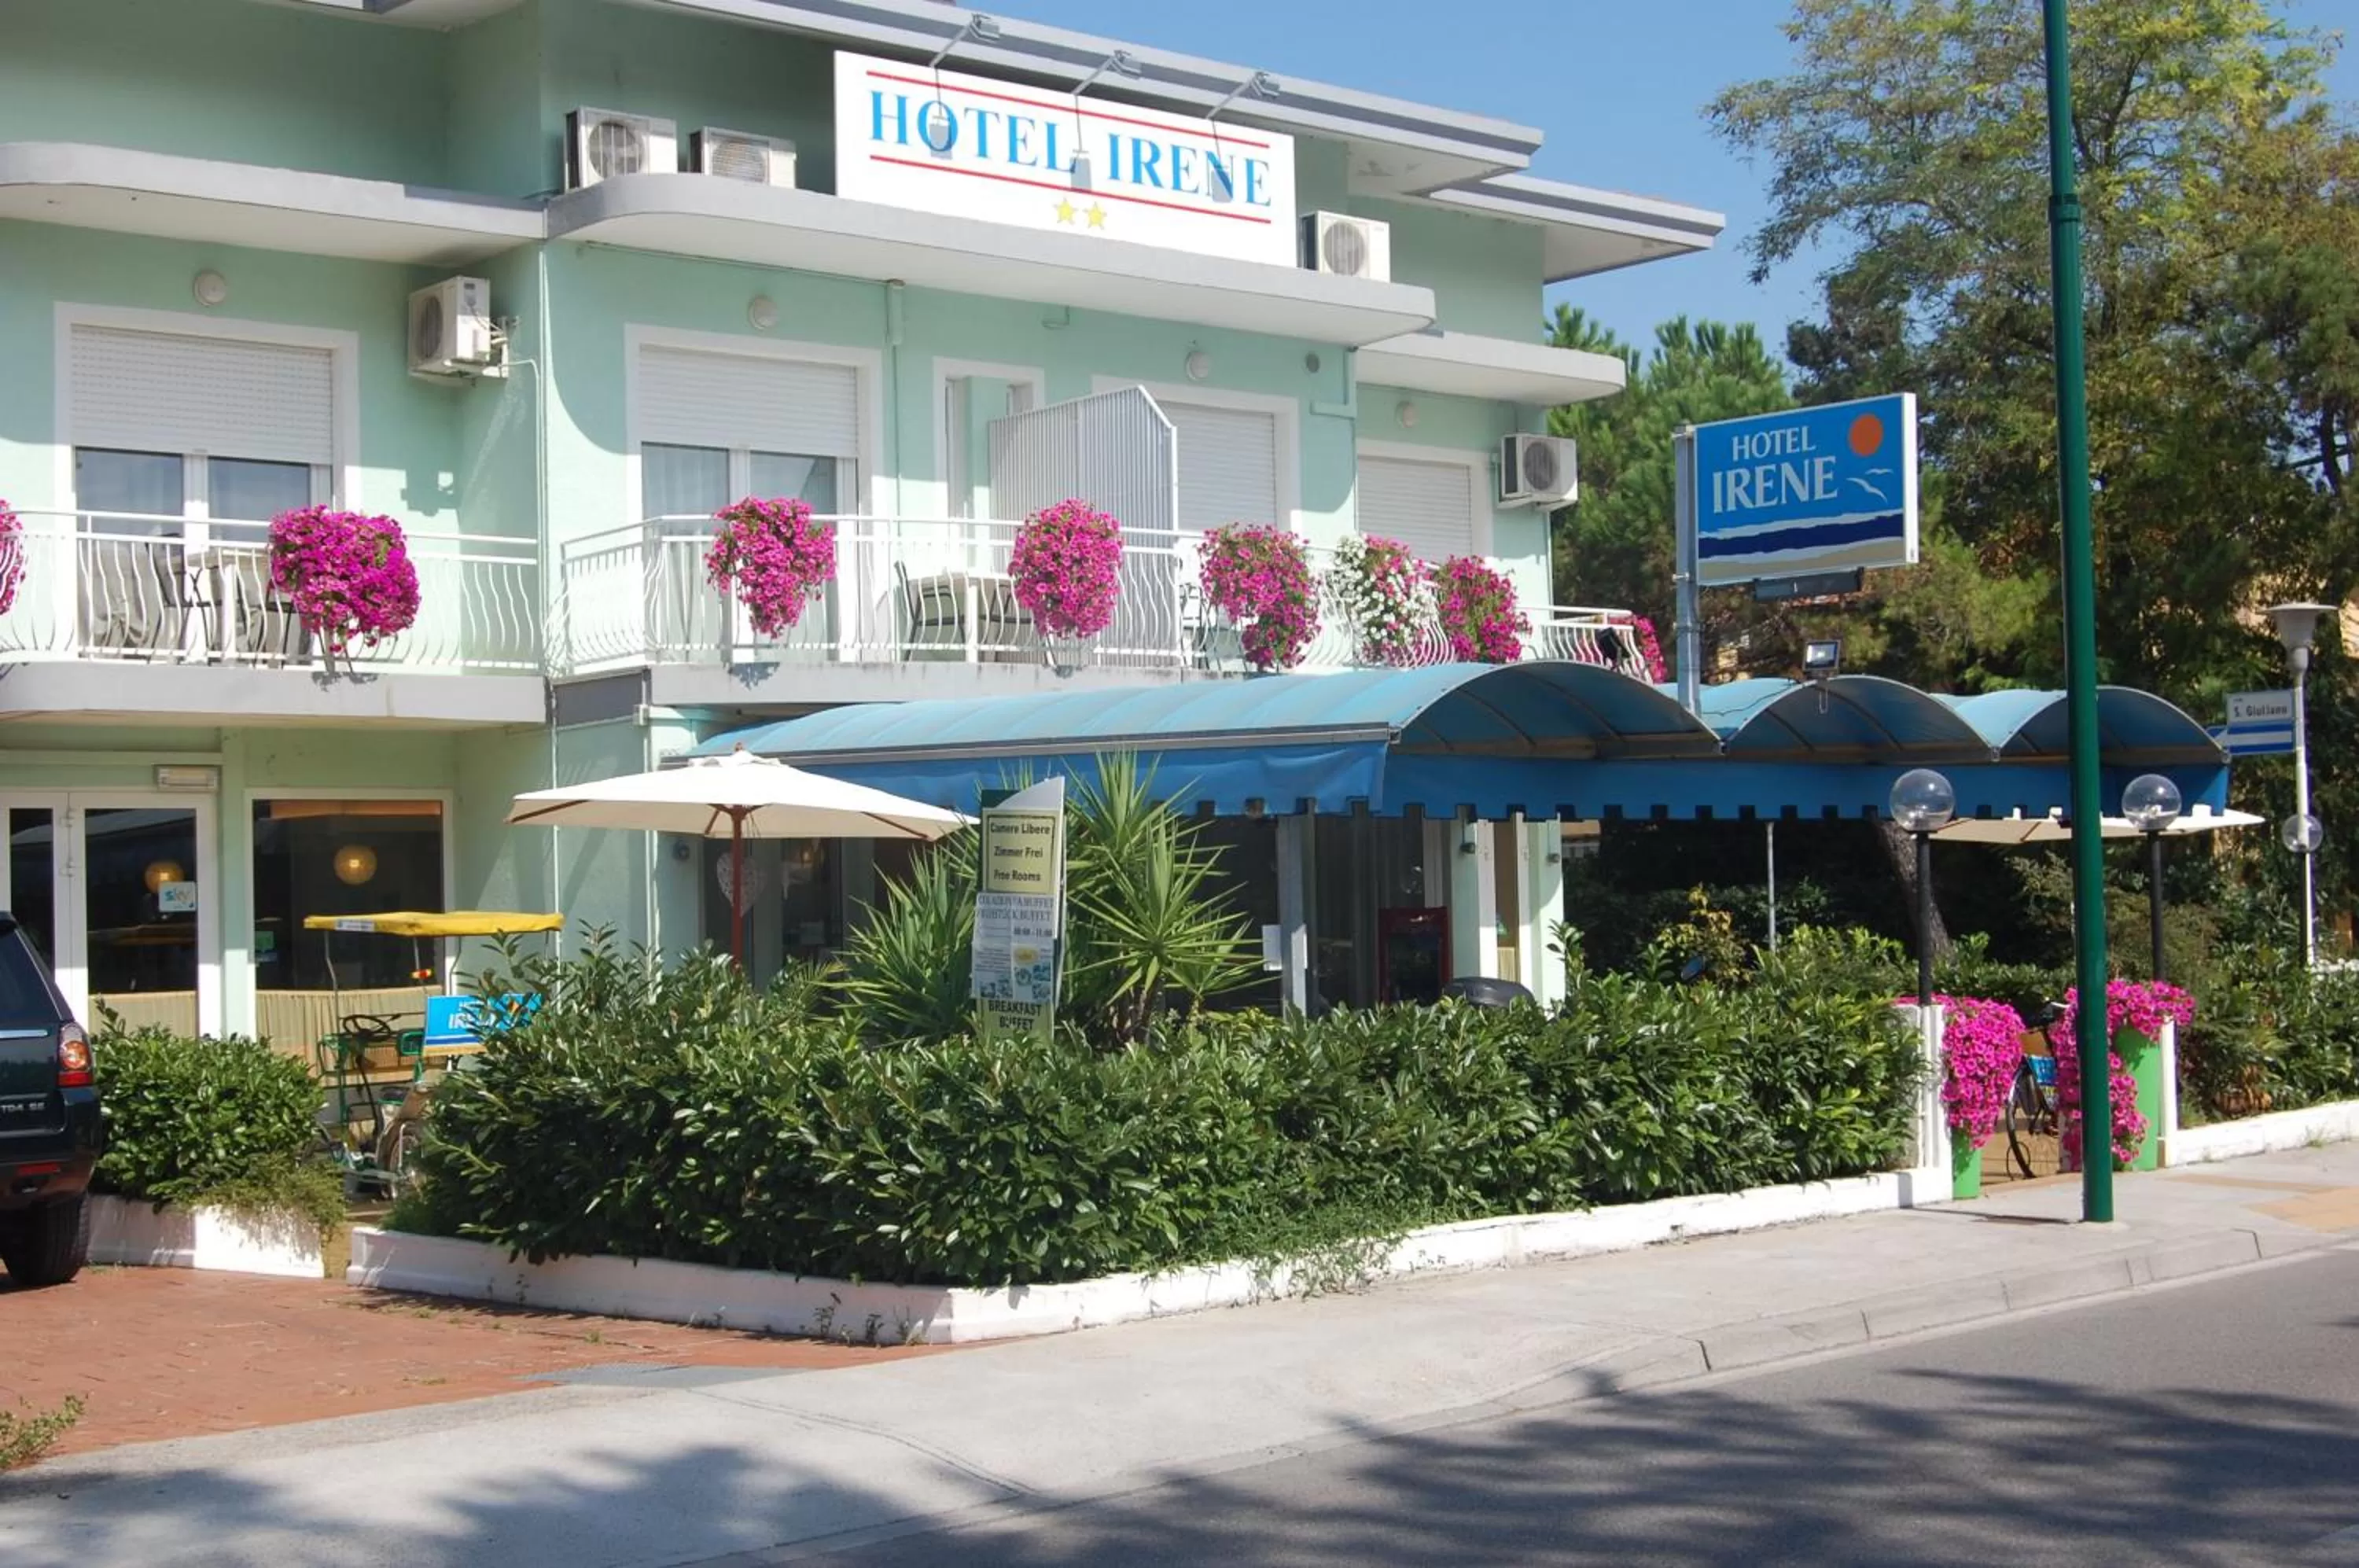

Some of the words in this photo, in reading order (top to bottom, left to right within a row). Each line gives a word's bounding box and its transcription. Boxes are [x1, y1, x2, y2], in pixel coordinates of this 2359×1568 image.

[868, 89, 1077, 174] HOTEL
[1107, 132, 1272, 207] IRENE
[1732, 425, 1816, 462] HOTEL
[1713, 456, 1838, 514] IRENE
[1021, 823, 1051, 835] Libere
[994, 845, 1023, 856] Zimmer
[1025, 846, 1043, 858] Frei
[994, 870, 1010, 880] Free
[1012, 870, 1041, 882] Rooms
[988, 999, 1042, 1017] BREAKFAST
